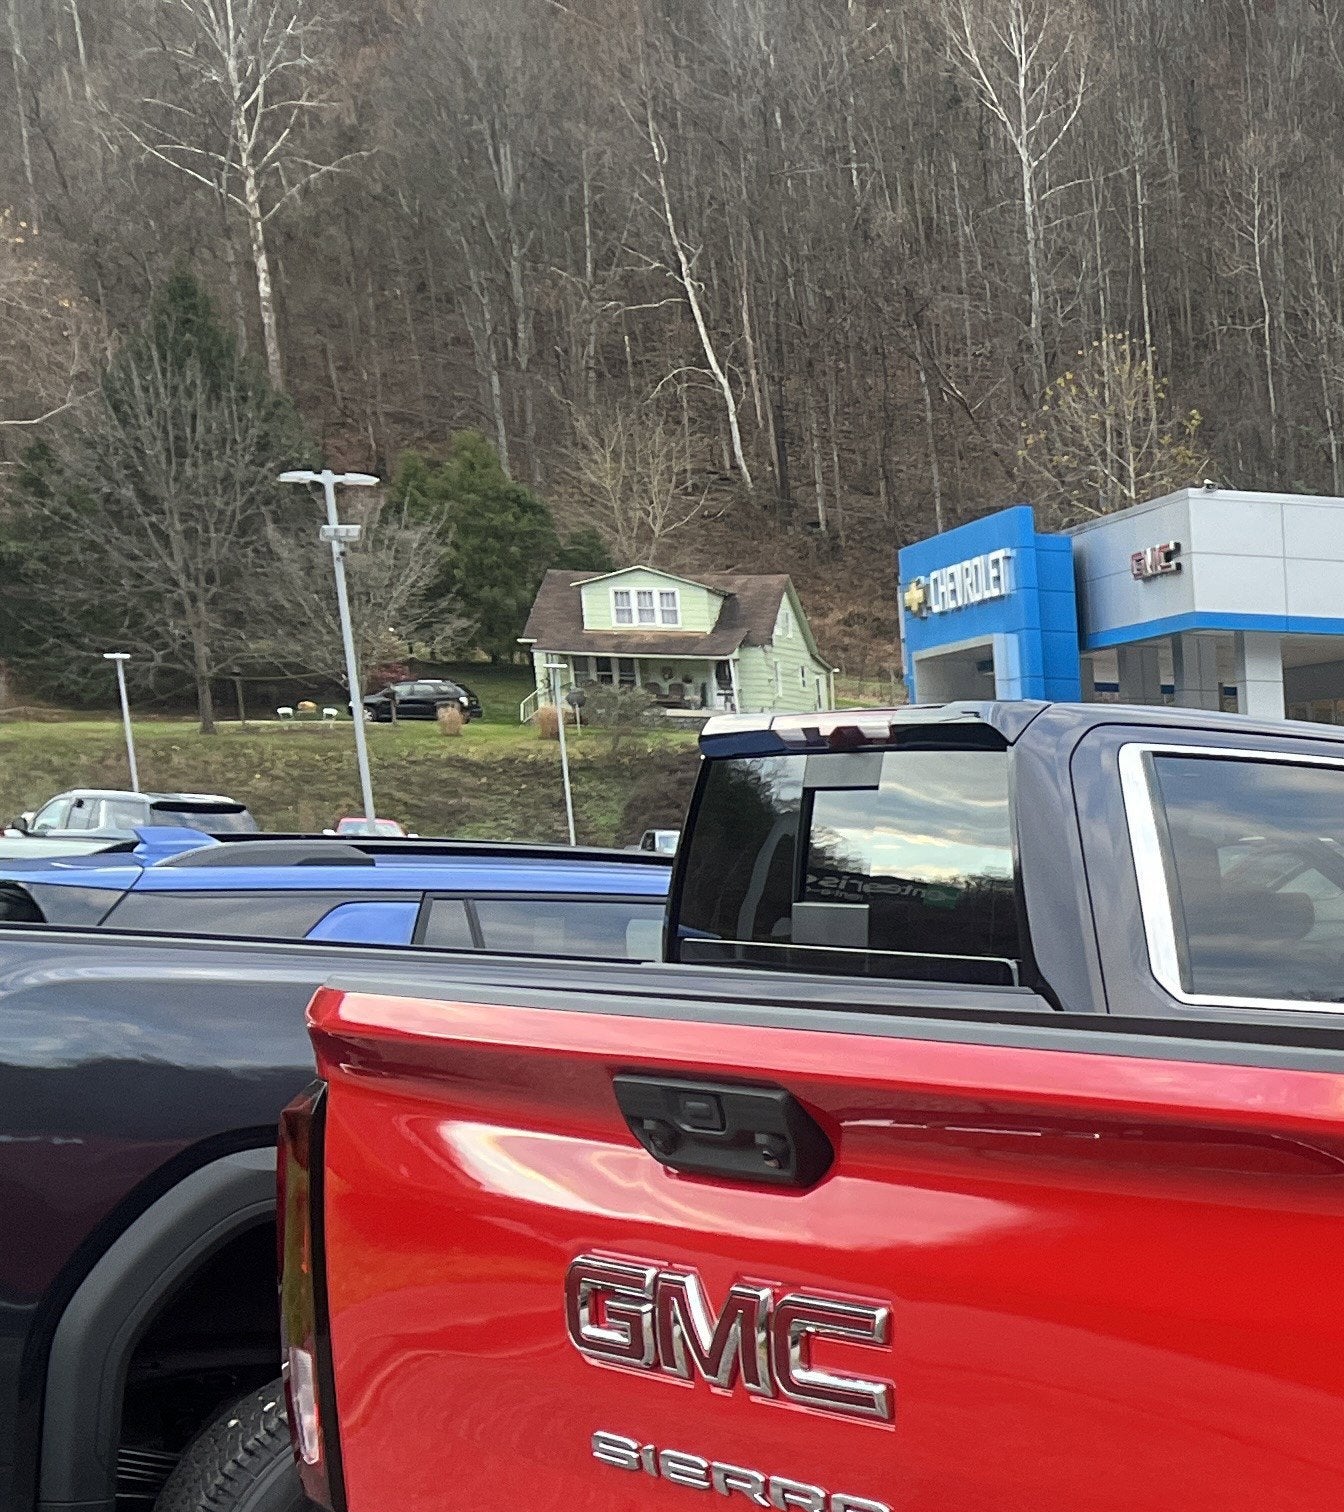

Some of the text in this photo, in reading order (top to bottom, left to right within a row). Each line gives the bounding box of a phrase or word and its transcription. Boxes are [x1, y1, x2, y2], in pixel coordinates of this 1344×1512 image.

[930, 547, 1017, 613] CHEVROLET
[1131, 541, 1182, 580] GMC
[565, 1252, 894, 1420] GMC
